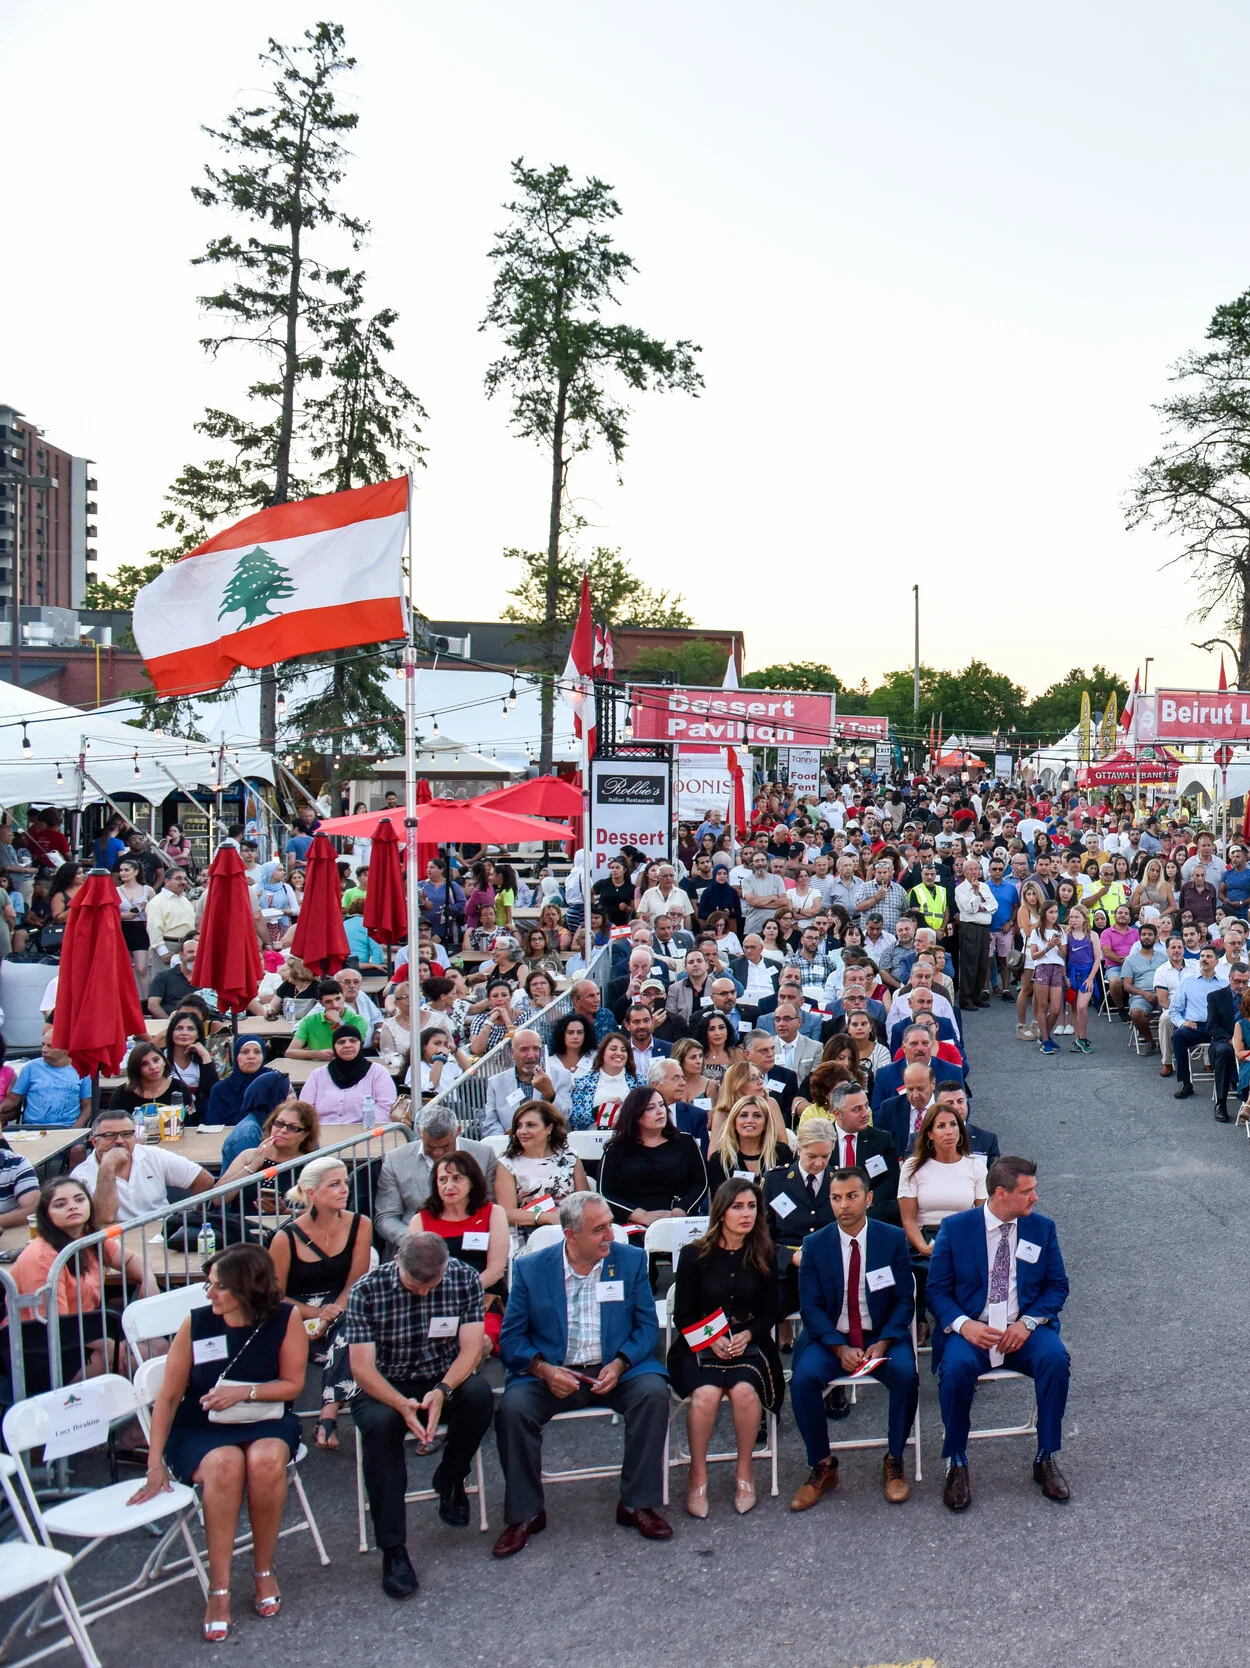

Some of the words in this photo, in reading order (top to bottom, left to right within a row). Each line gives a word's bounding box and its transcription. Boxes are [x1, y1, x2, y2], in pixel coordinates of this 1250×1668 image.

[668, 694, 795, 718] Dessert
[1161, 699, 1233, 725] Beirut
[667, 718, 795, 742] Pavilion
[791, 755, 818, 764] Tannis
[790, 771, 818, 780] Food
[1095, 771, 1130, 780] OTTAWA
[601, 776, 661, 796] Robbie's
[791, 782, 817, 791] Tent
[596, 828, 664, 846] Dessert
[55, 1428, 71, 1437] Lucy
[72, 1418, 100, 1431] Ibrahim
